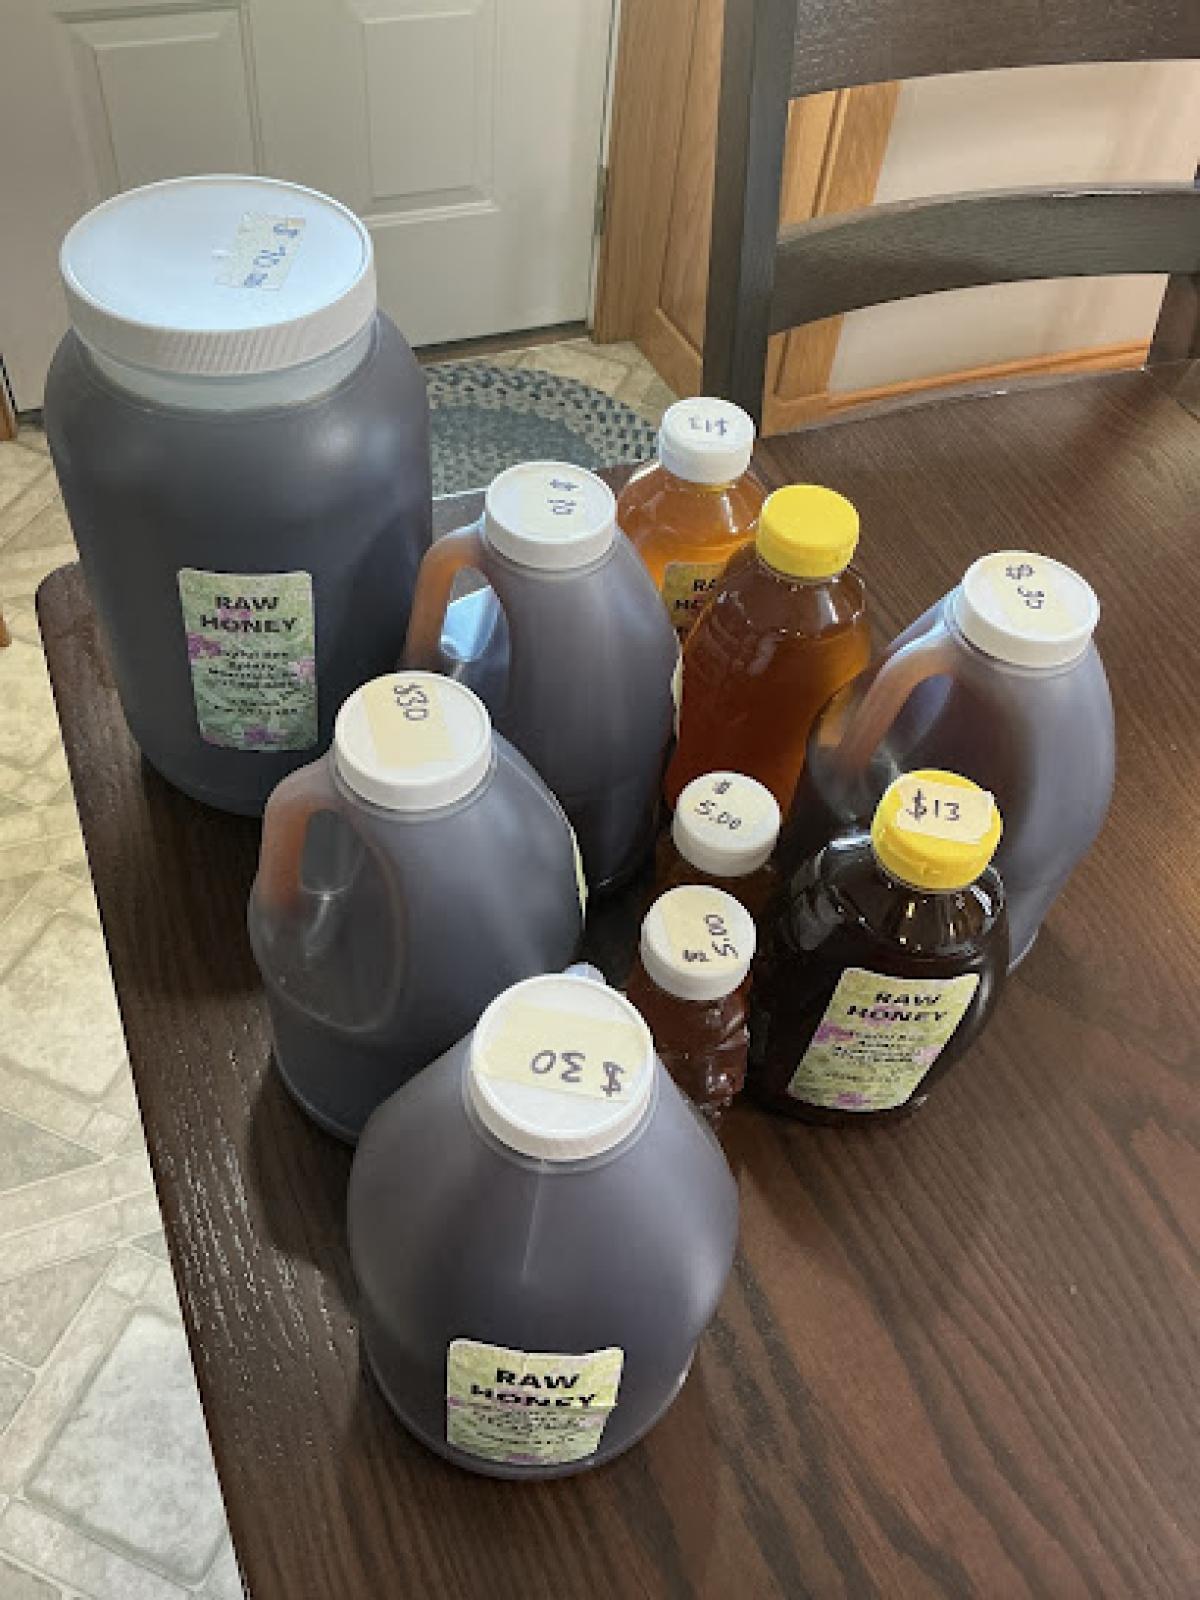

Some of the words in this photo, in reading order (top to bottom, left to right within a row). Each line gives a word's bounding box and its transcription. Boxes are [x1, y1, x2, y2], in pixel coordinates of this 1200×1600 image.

[215, 596, 279, 609] RAW
[202, 614, 297, 633] HONEY
[905, 787, 961, 823] $13
[876, 992, 942, 1006] RAW
[846, 1005, 948, 1021] HONEY
[530, 1049, 586, 1083] 30
[600, 1061, 625, 1097] $
[496, 1367, 580, 1389] RAW
[470, 1384, 597, 1408] HONEY
